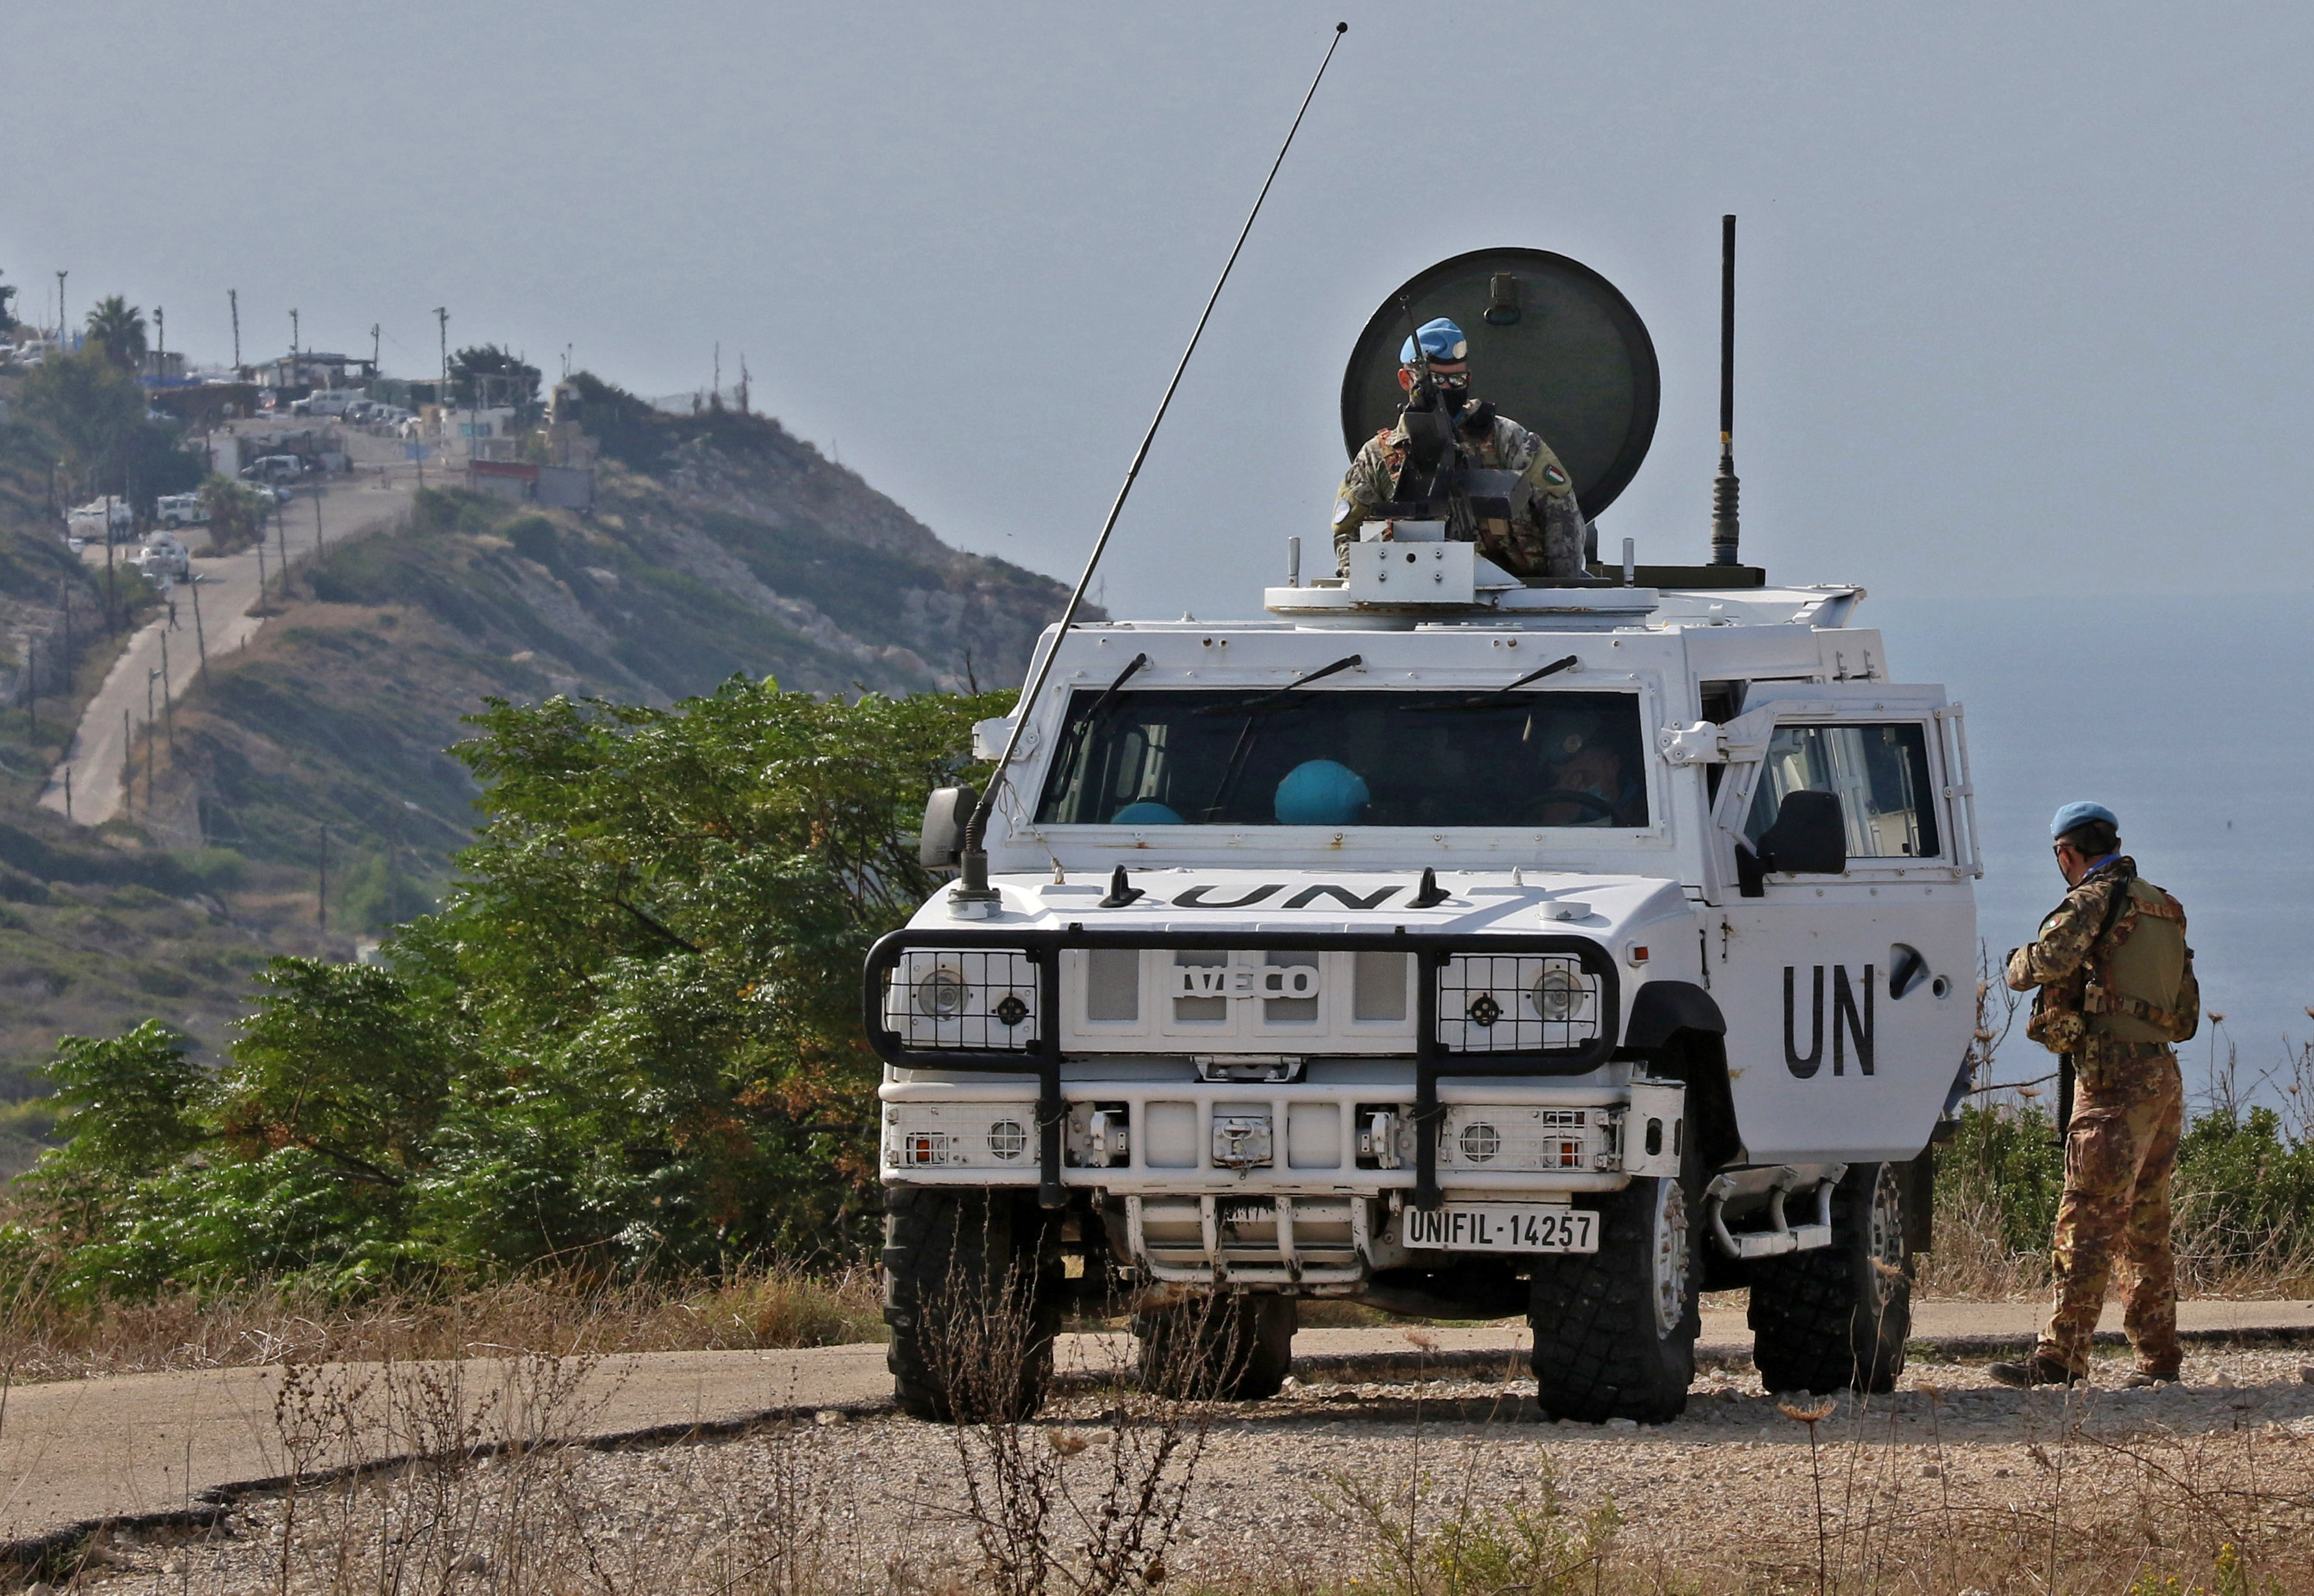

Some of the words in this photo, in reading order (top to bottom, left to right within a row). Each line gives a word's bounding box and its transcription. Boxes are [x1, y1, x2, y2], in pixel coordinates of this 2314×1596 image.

[1171, 884, 1406, 909] UN
[1172, 965, 1320, 999] IVECO
[1784, 964, 1874, 1079] UN
[1410, 1211, 1591, 1247] UNIFIL-14257
